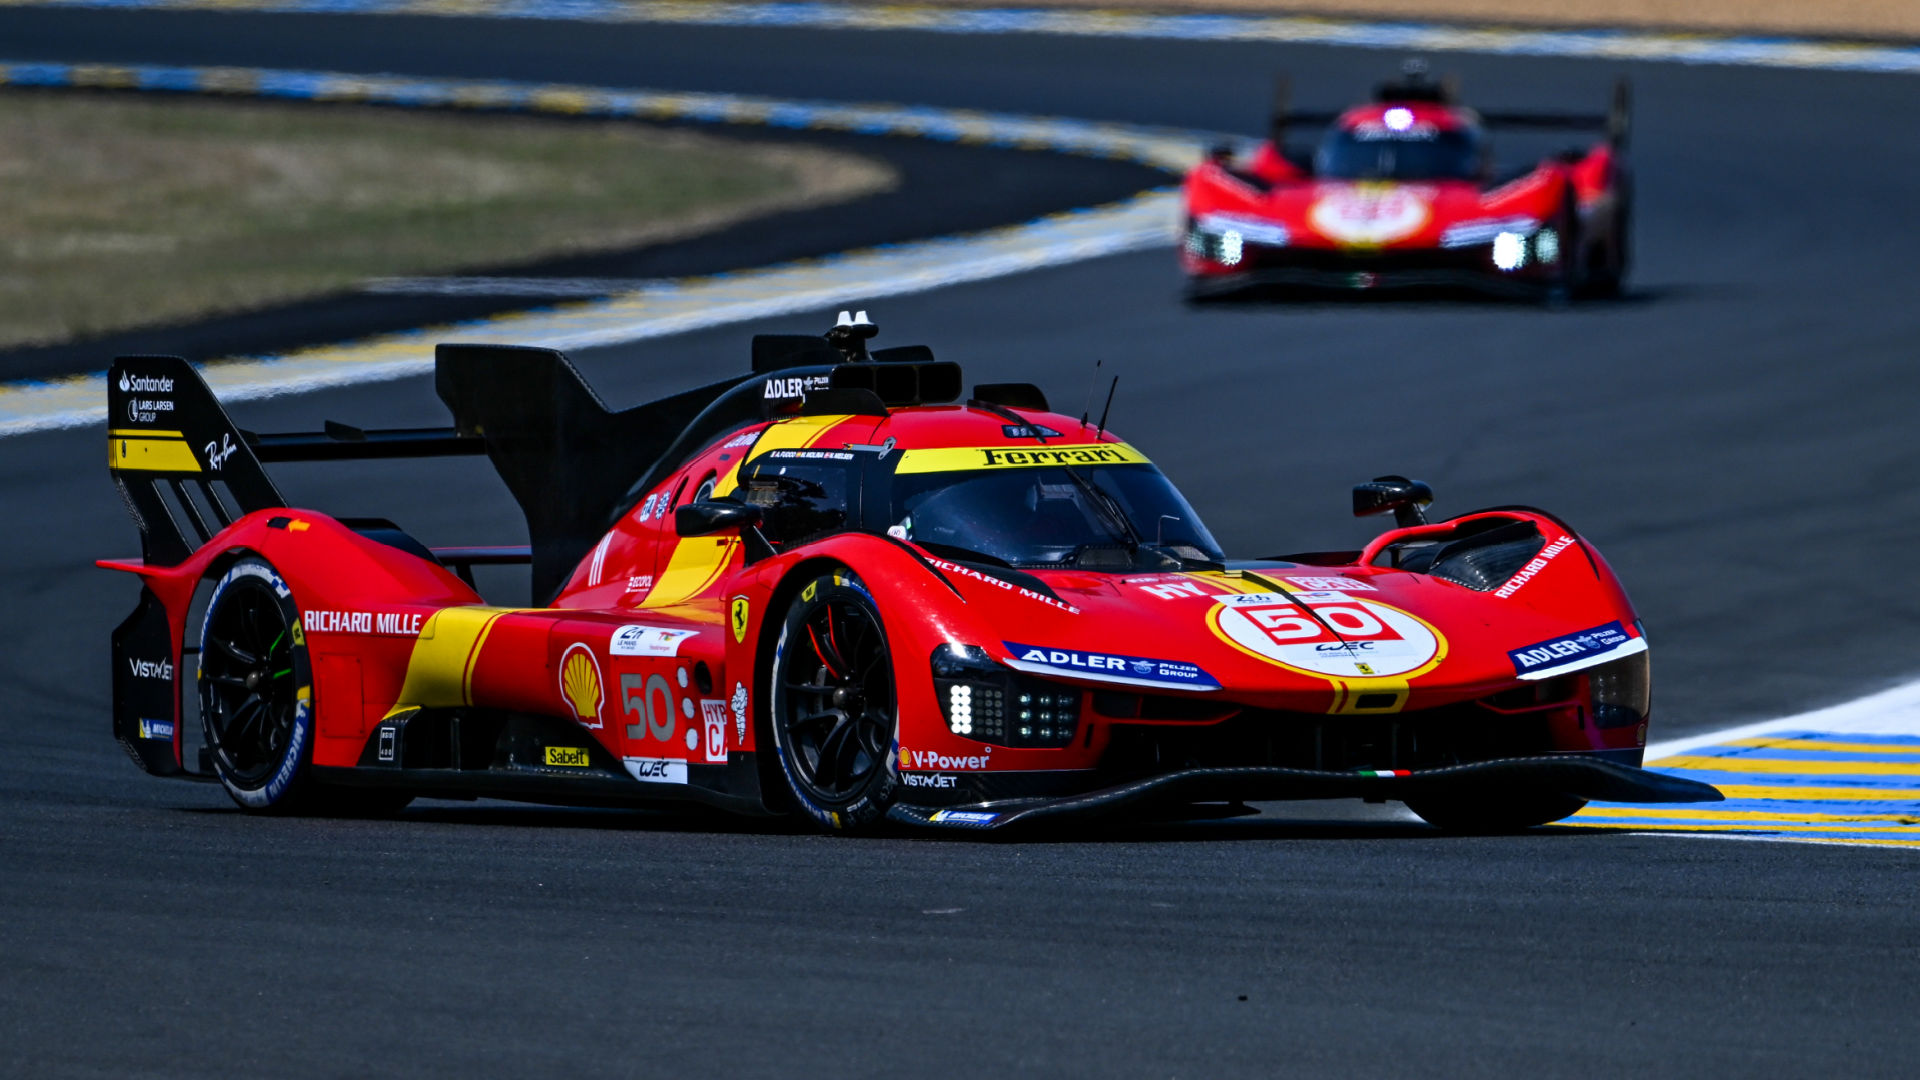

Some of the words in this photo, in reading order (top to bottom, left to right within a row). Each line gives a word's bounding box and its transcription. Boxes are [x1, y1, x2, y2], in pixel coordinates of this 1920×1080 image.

[131, 375, 174, 392] Santander
[764, 378, 803, 398] ADLER
[139, 401, 152, 410] LARS
[153, 401, 174, 410] LARSEN
[139, 413, 156, 422] GROUP
[977, 446, 1129, 466] Ferrari
[1494, 558, 1547, 599] RICHARD
[1540, 535, 1576, 560] MILLE
[1019, 588, 1080, 615] MILLE
[305, 610, 372, 634] RICHARD
[376, 613, 422, 636] MILLE
[1246, 606, 1383, 640] 50
[1590, 629, 1618, 640] PELZER
[1020, 649, 1126, 671] ADLER
[1515, 640, 1587, 668] ADLER
[1159, 662, 1198, 672] PELZER
[1159, 668, 1198, 679] GROUP
[620, 673, 675, 742] 50
[550, 748, 584, 765] Sabelt
[912, 750, 990, 769] V-Power
